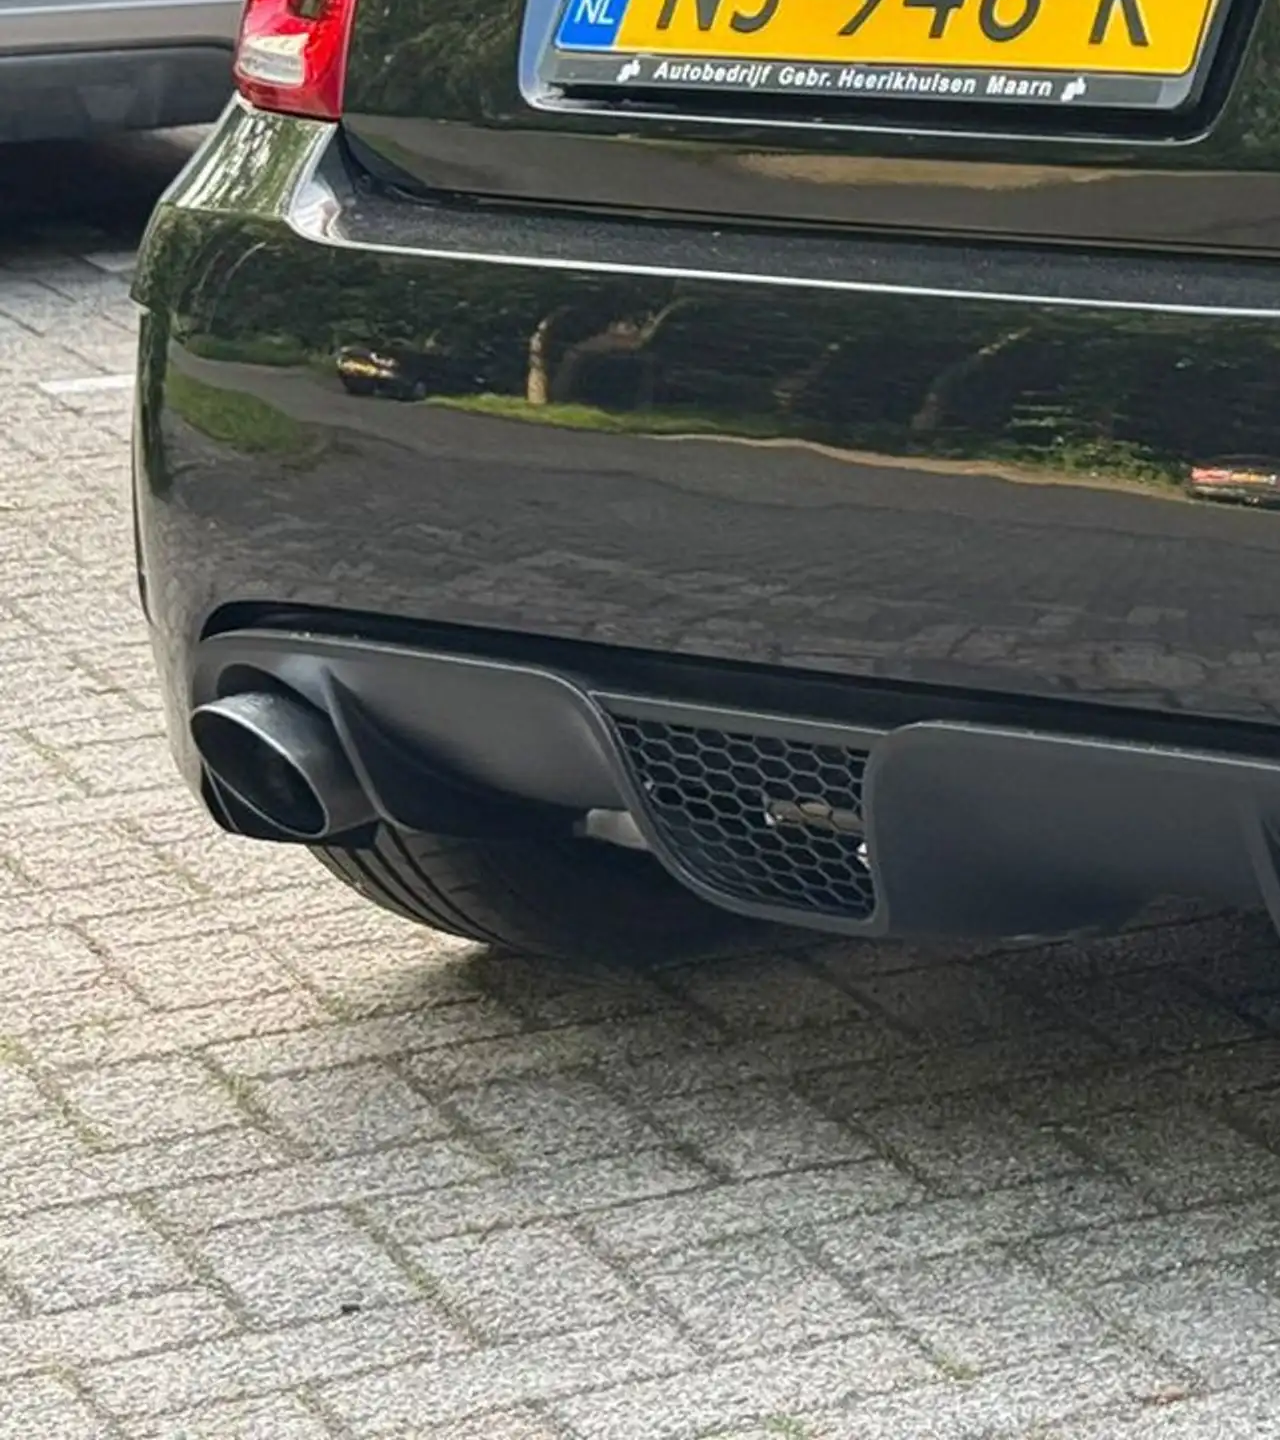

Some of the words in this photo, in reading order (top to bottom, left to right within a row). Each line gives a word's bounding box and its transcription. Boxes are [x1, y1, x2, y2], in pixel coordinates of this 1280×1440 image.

[653, 61, 773, 88] Autobedrijf
[778, 66, 832, 88] Gebr.
[837, 68, 977, 94] Heerikhuisen
[985, 75, 1053, 98] Maarn
